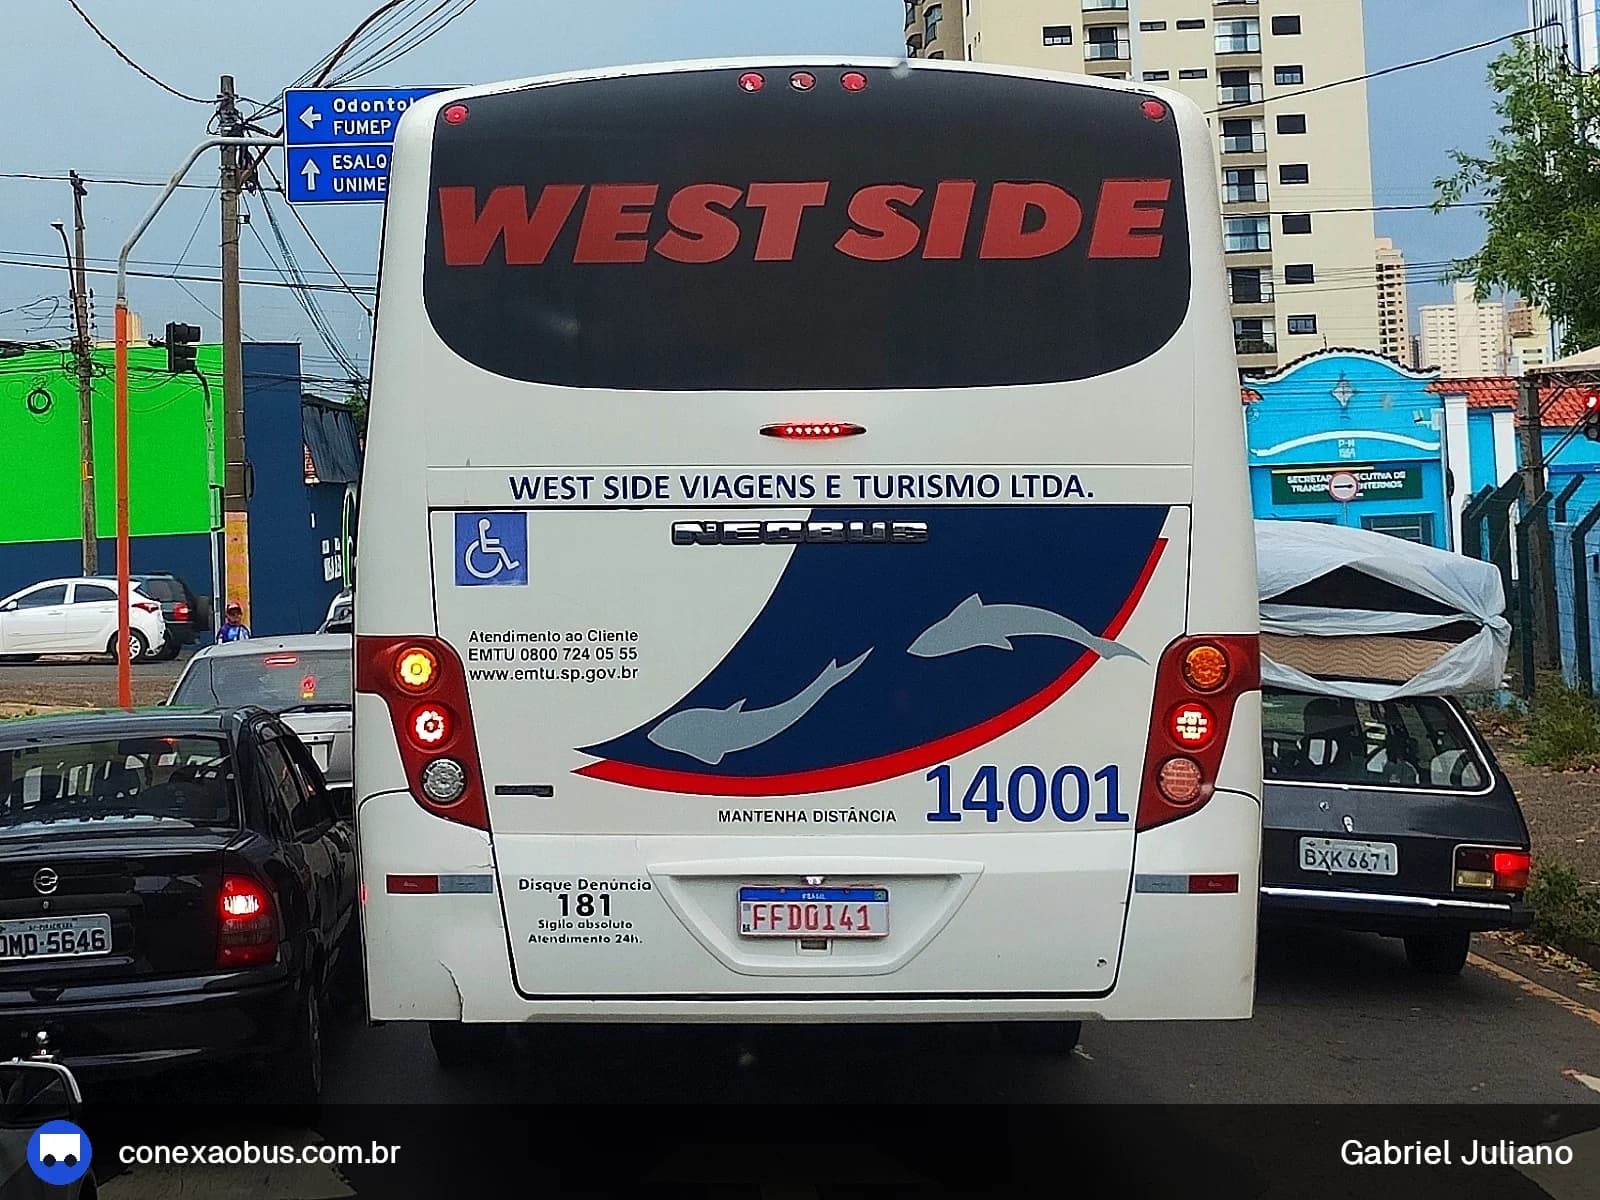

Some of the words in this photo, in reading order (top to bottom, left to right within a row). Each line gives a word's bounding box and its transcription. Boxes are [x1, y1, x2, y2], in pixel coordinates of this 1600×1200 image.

[333, 119, 392, 136] FUMEP
[332, 154, 387, 170] ESALQ
[437, 180, 830, 266] WEST
[834, 178, 1172, 261] SIDE
[508, 475, 595, 500] WEST
[603, 475, 671, 500] SIDE
[679, 474, 816, 500] VIAGENS
[826, 474, 841, 499] E
[852, 474, 1001, 499] TURISMO
[1011, 474, 1095, 499] LTDA.
[672, 521, 929, 546] NEOBUS
[468, 630, 561, 643] Atendimento
[565, 632, 583, 642] ao
[587, 630, 639, 642] Cliente
[468, 648, 515, 661] EMTU
[520, 648, 558, 661] 0800
[563, 648, 590, 660] 724
[595, 648, 614, 660] 05
[619, 647, 638, 660] 55
[468, 666, 639, 683] www.emtu.sp.gov.br
[925, 764, 1130, 823] 14001
[718, 809, 807, 823] MANTENHA
[813, 806, 897, 823] DISTÂNCIA
[1305, 848, 1344, 869] BXK
[1347, 852, 1390, 871] 6671
[518, 878, 572, 893] Disque
[578, 878, 652, 891] Denúncia
[557, 893, 611, 917] 181
[537, 919, 574, 932] Sigilo
[577, 919, 633, 929] absoluto
[528, 934, 611, 944] Atendimento
[615, 934, 643, 944] 24h.
